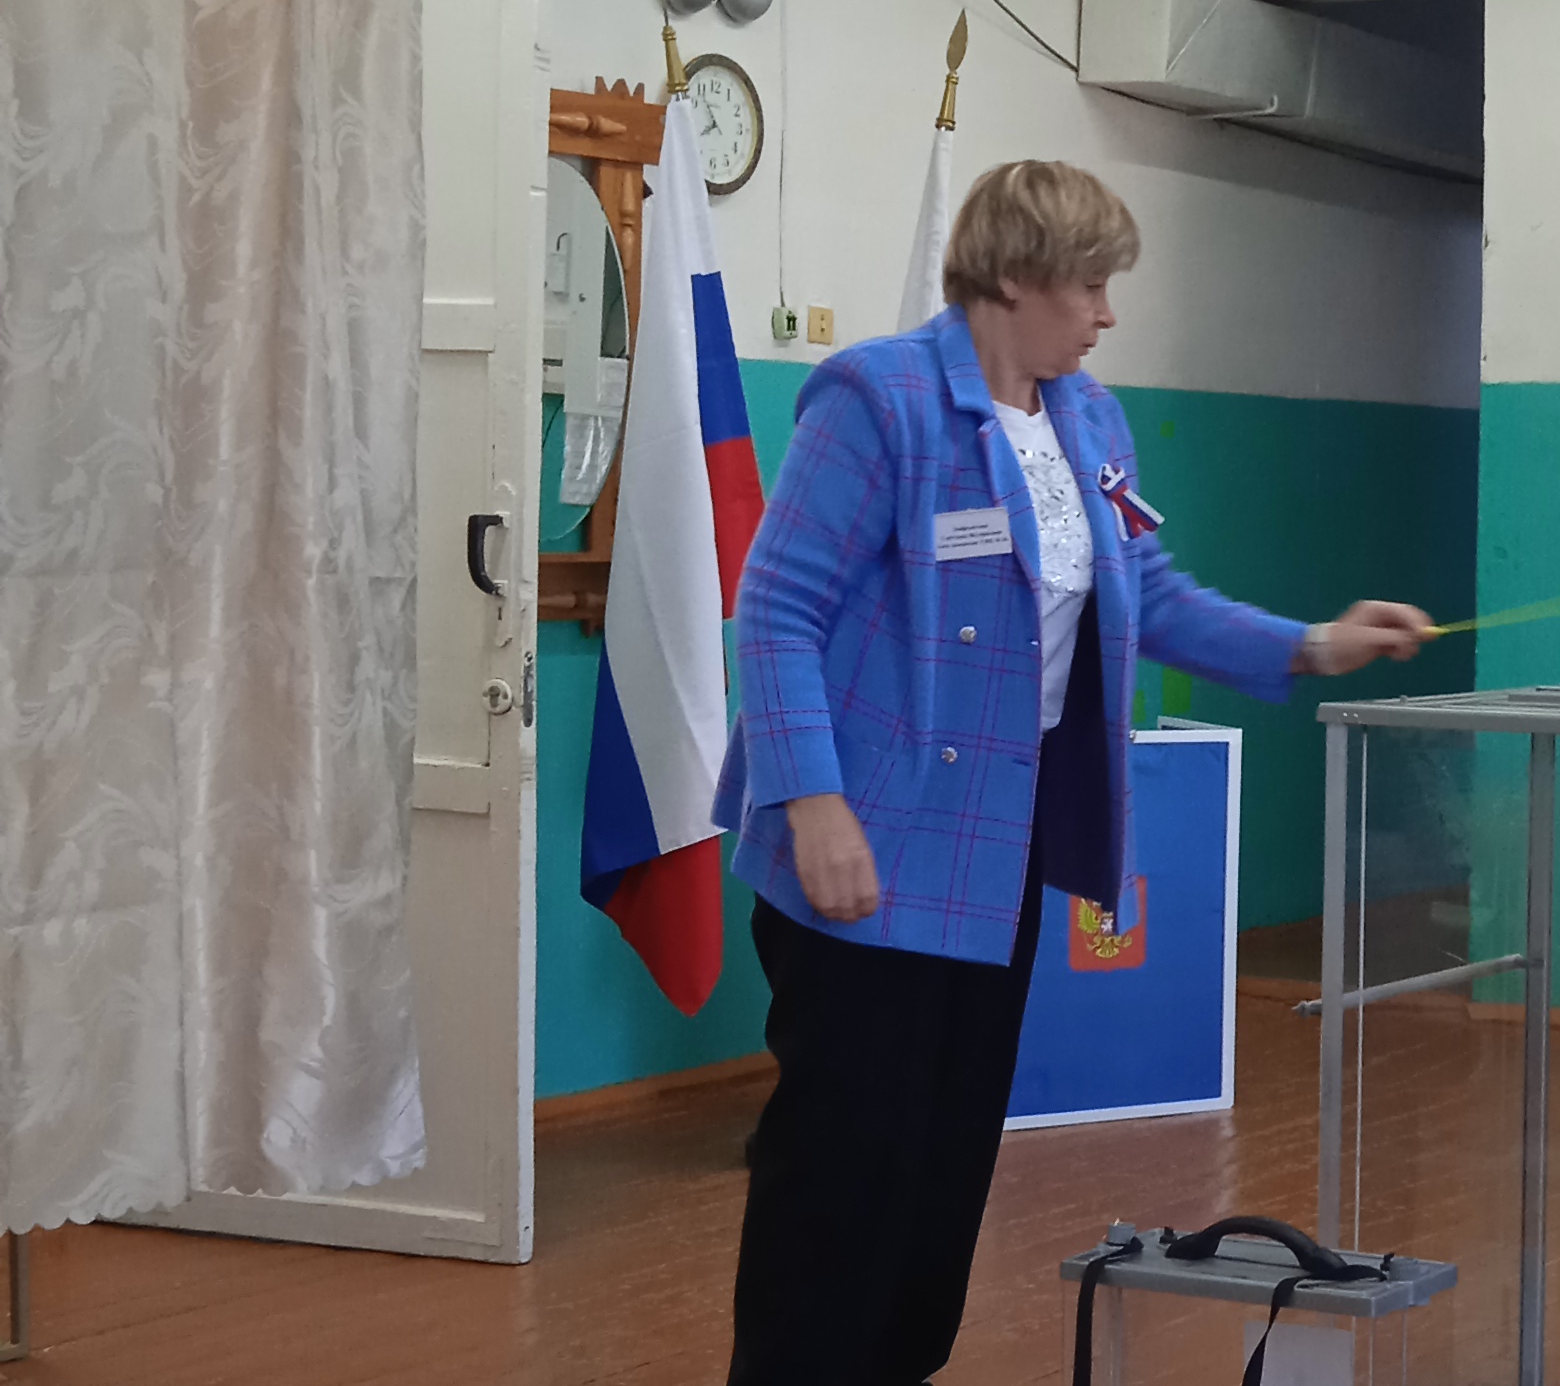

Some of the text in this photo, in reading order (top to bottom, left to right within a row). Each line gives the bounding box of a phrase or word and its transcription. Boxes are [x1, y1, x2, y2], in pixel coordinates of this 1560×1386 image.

[711, 79, 721, 94] 12
[726, 88, 731, 102] 1
[733, 104, 741, 118] 2
